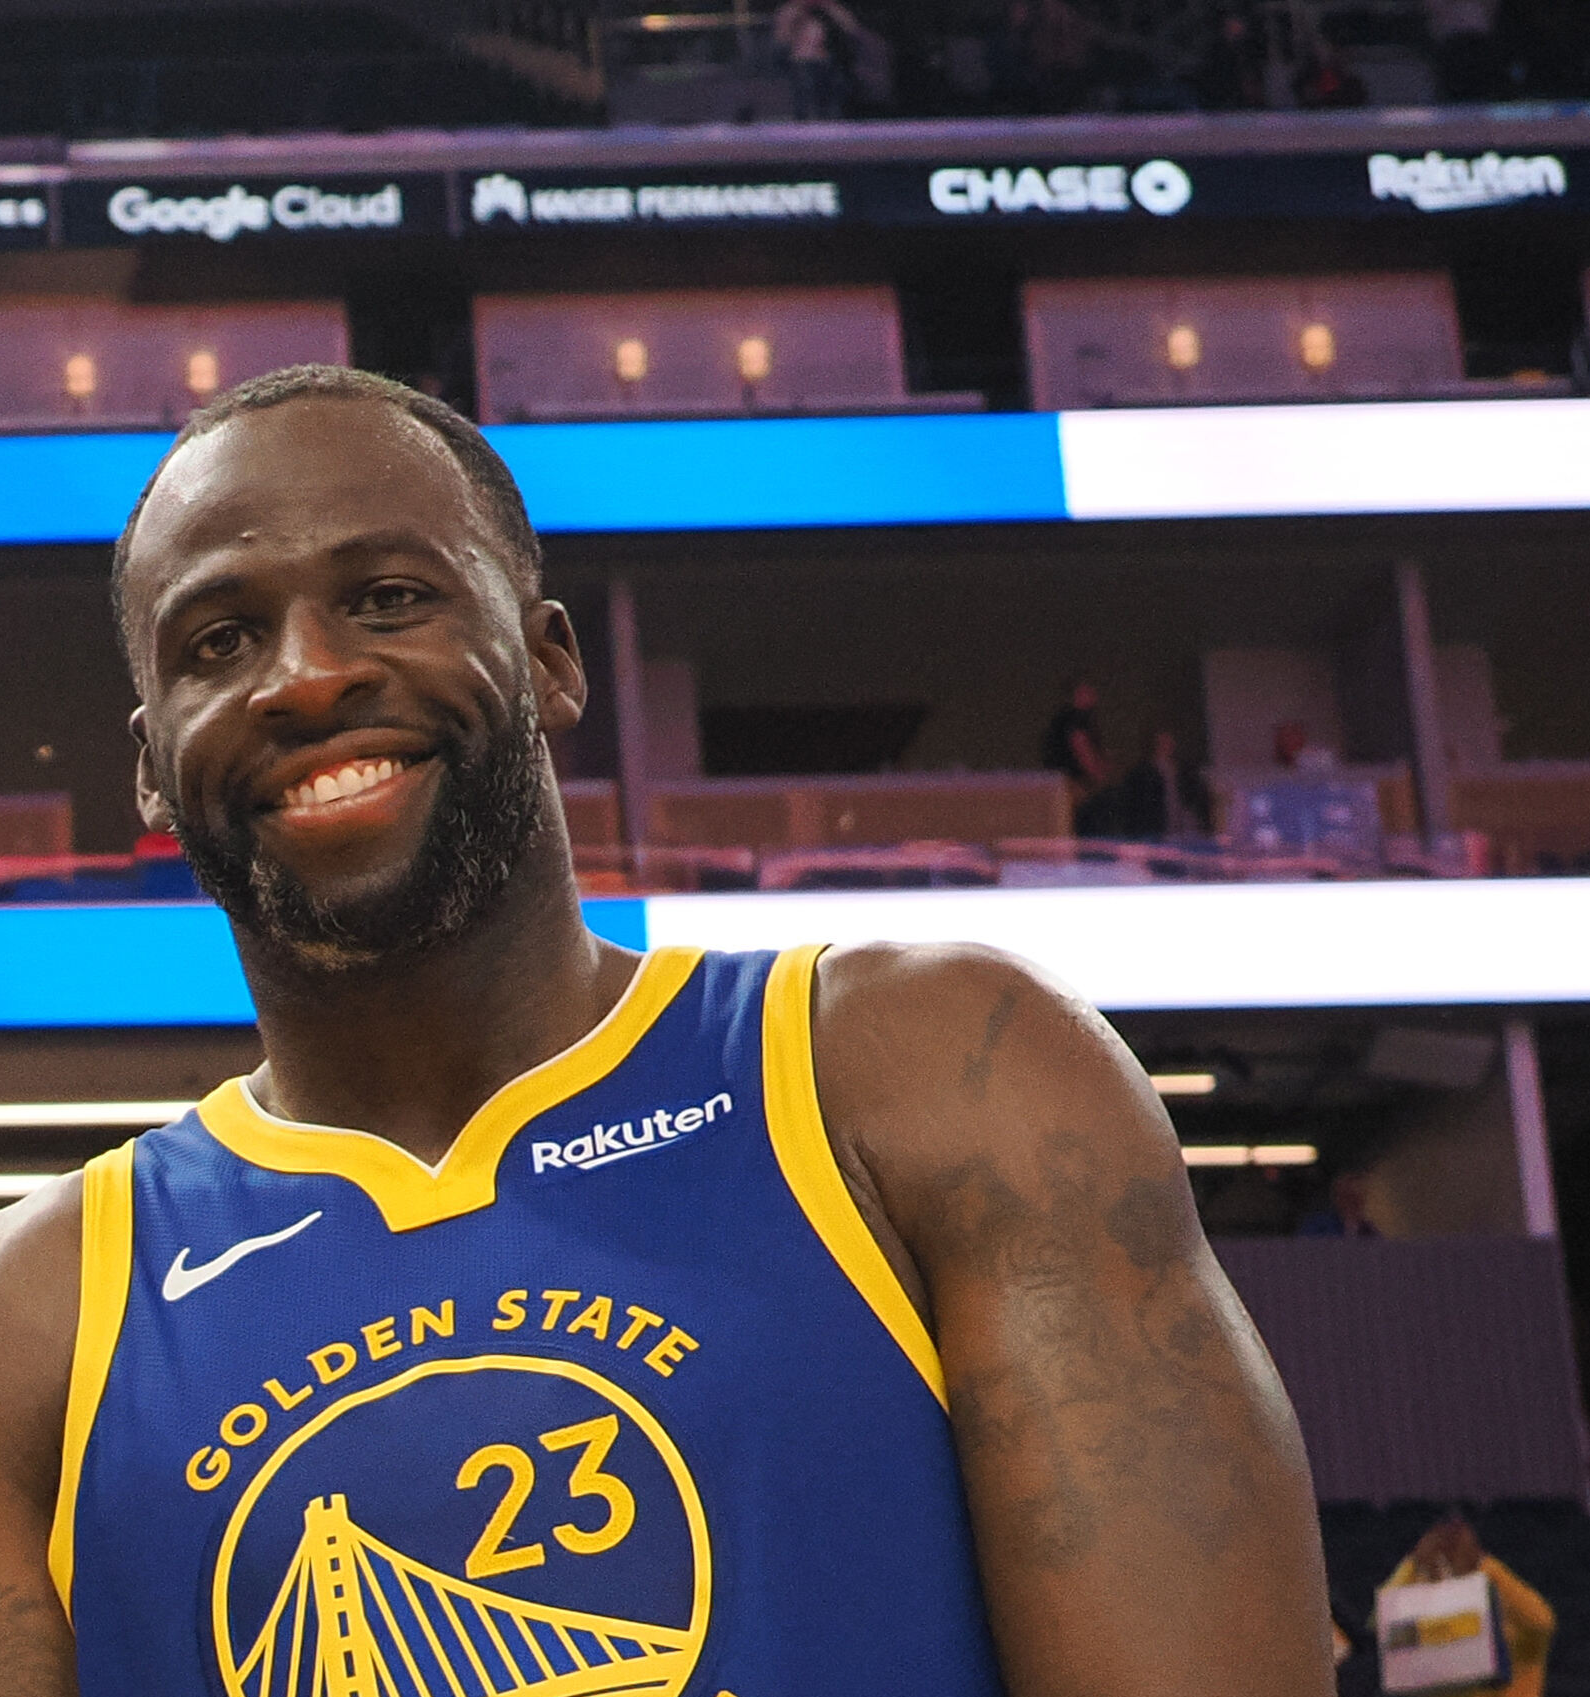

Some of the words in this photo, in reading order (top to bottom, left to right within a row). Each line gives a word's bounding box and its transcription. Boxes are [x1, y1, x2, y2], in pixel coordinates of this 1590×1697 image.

[108, 185, 269, 241] Google
[271, 184, 401, 228] Cloud
[929, 165, 1129, 213] CHASE
[1367, 151, 1566, 211] Rakuten
[531, 1091, 733, 1176] Rakuten
[184, 1299, 457, 1493] GOLDEN
[491, 1288, 700, 1378] STATE
[455, 1413, 637, 1580] 23
